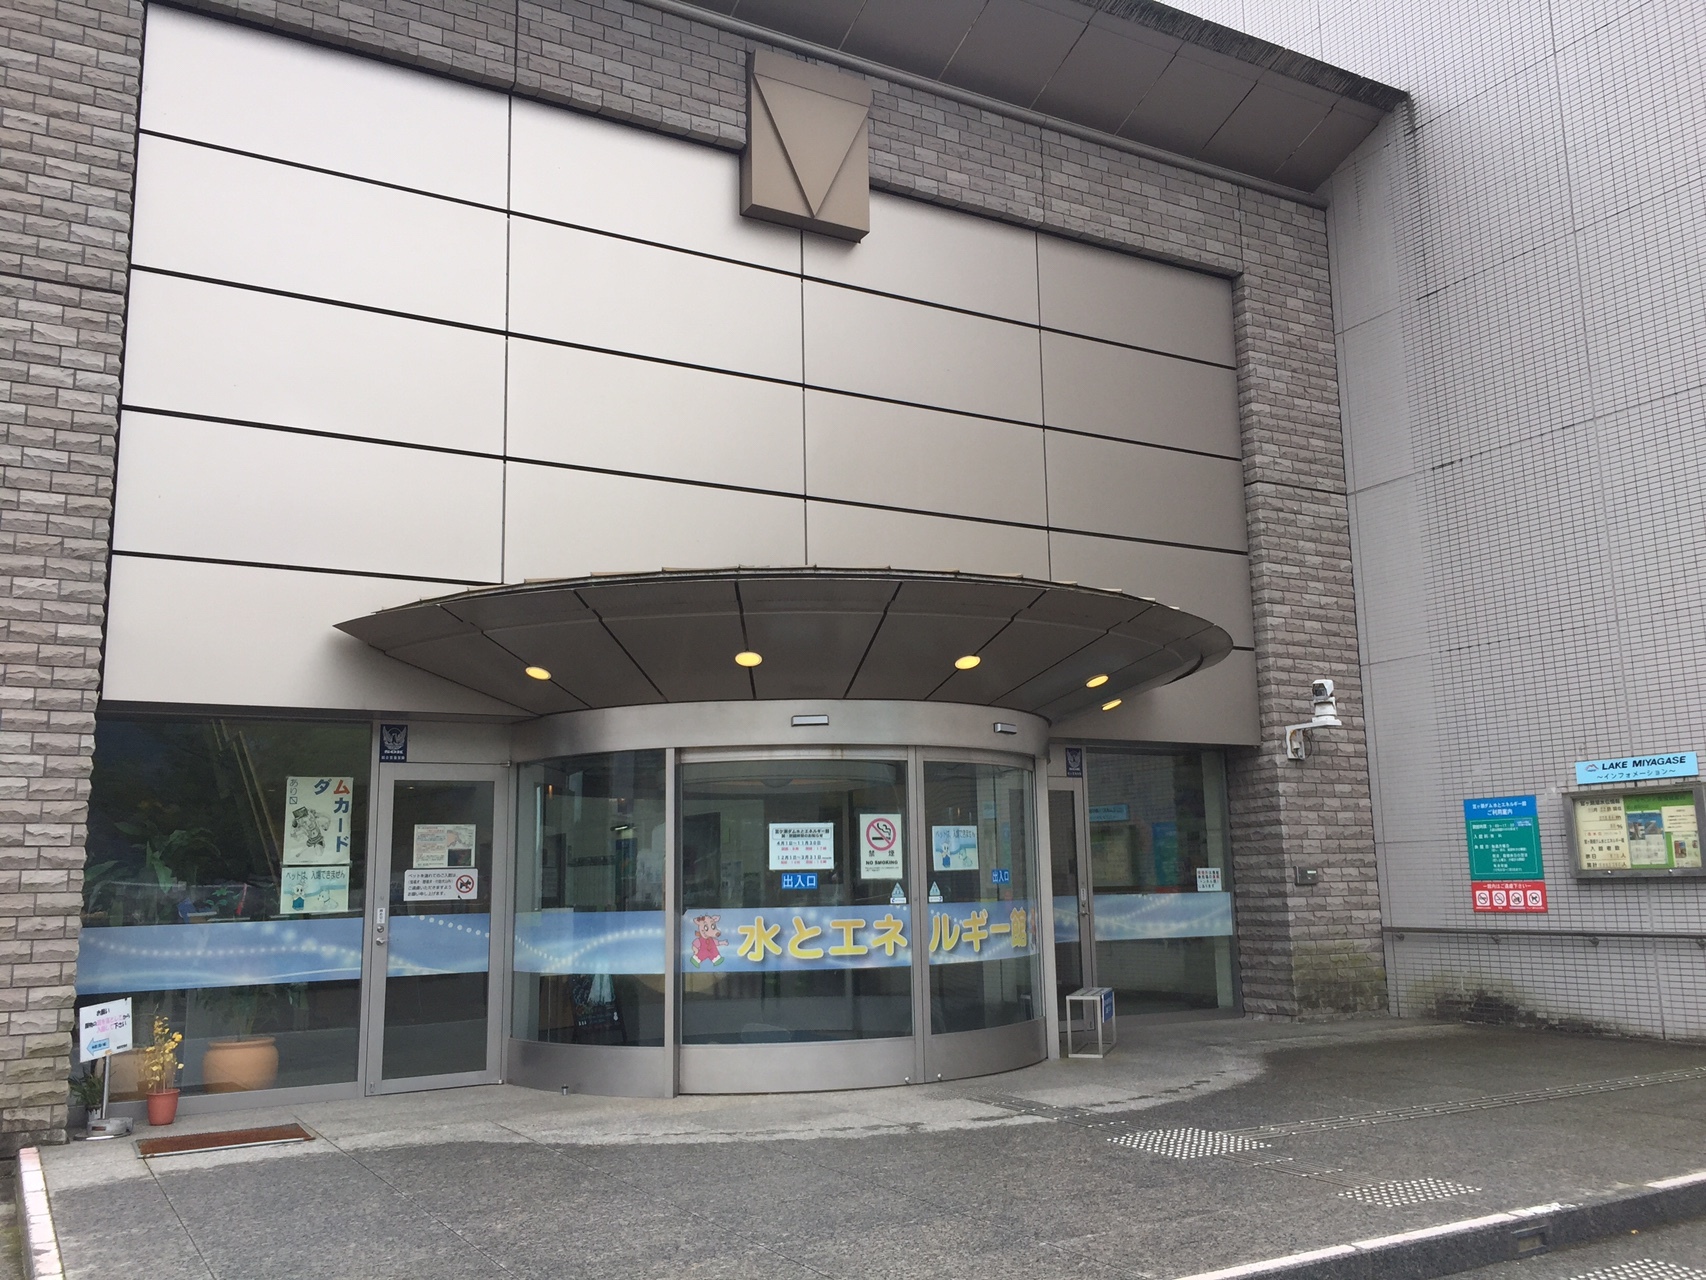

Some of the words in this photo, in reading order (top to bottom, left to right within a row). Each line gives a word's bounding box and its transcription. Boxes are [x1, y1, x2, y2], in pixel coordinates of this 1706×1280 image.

[1602, 761, 1628, 770] LAKE
[1632, 756, 1687, 768] MIYAGASE
[289, 778, 299, 795] あり
[783, 875, 817, 889] 出入口
[992, 870, 1010, 883] 出入口
